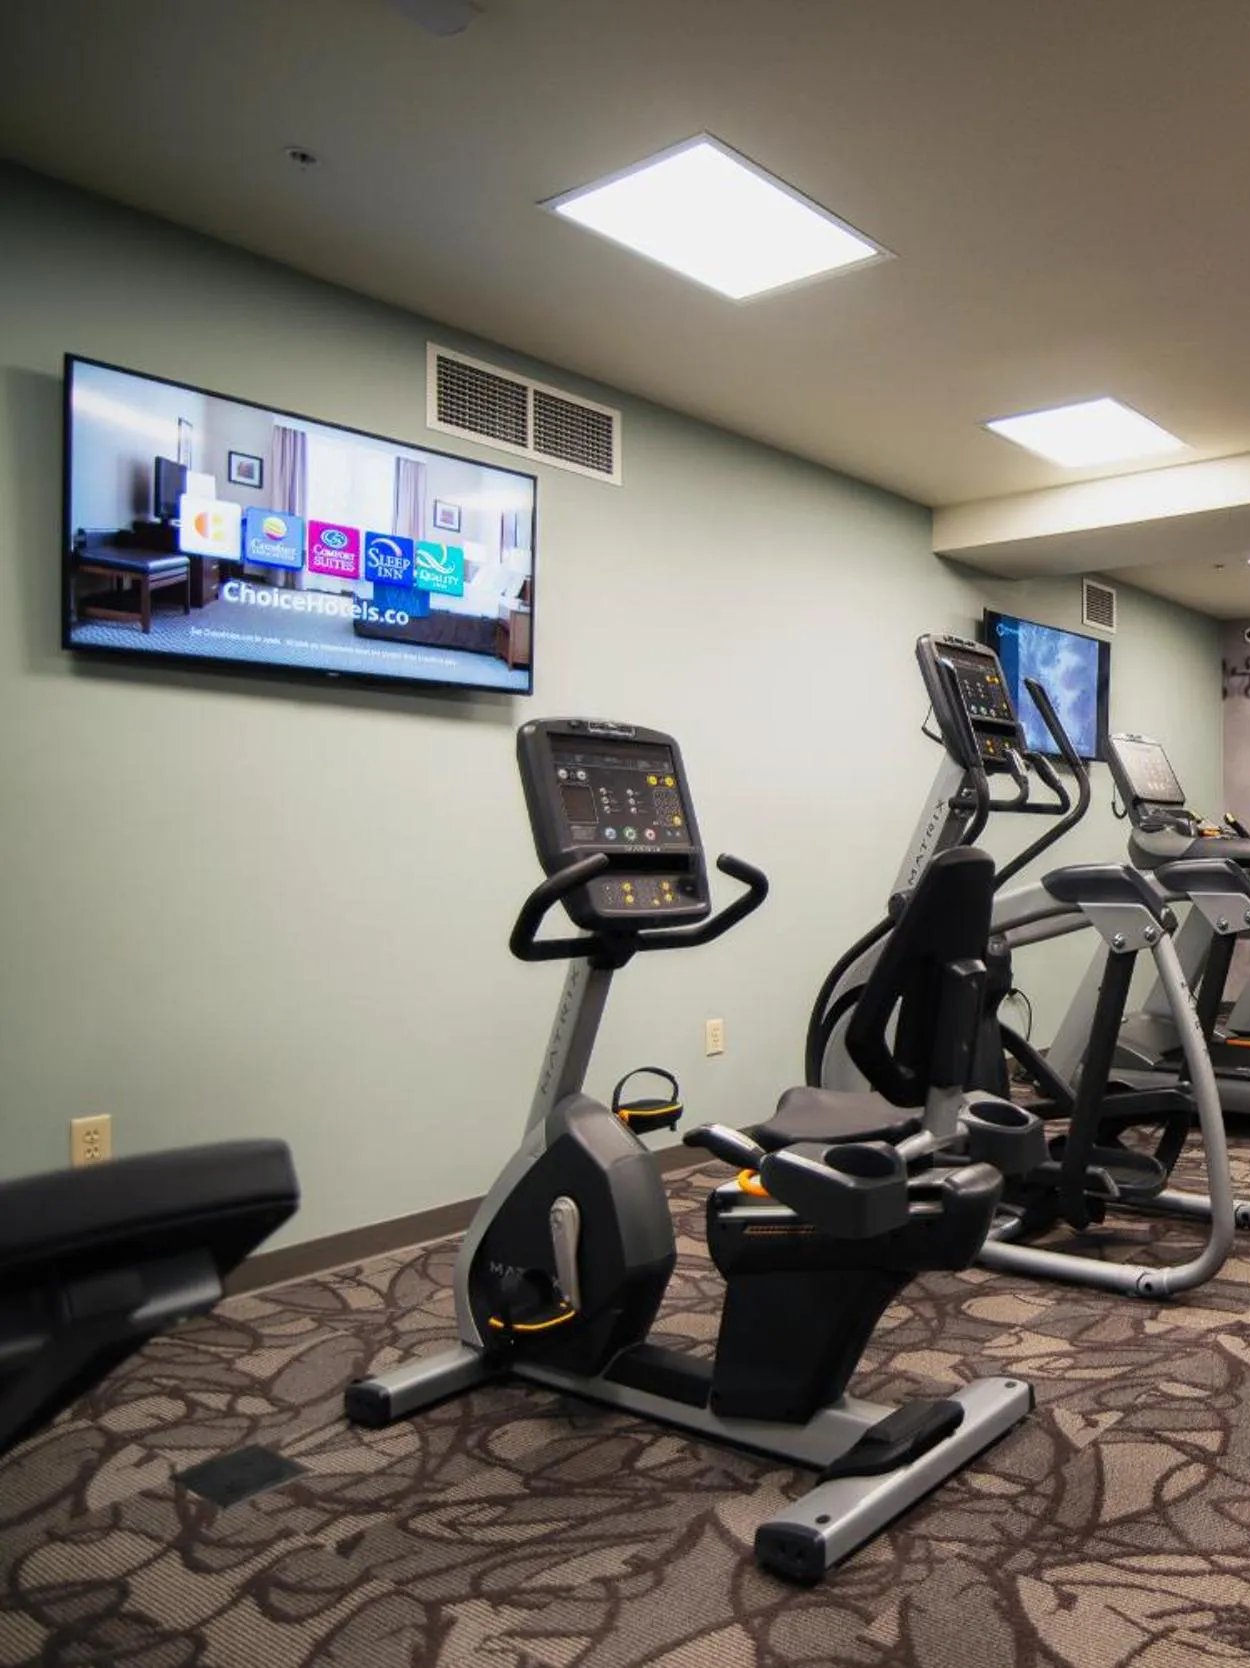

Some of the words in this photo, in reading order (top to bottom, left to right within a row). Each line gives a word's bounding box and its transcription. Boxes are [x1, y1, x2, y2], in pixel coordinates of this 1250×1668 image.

[313, 556, 356, 574] SUITES
[368, 547, 411, 571] SLEEP
[377, 566, 404, 580] INN
[222, 579, 410, 626] ChoiceHotels.co
[908, 800, 946, 886] MATRIX
